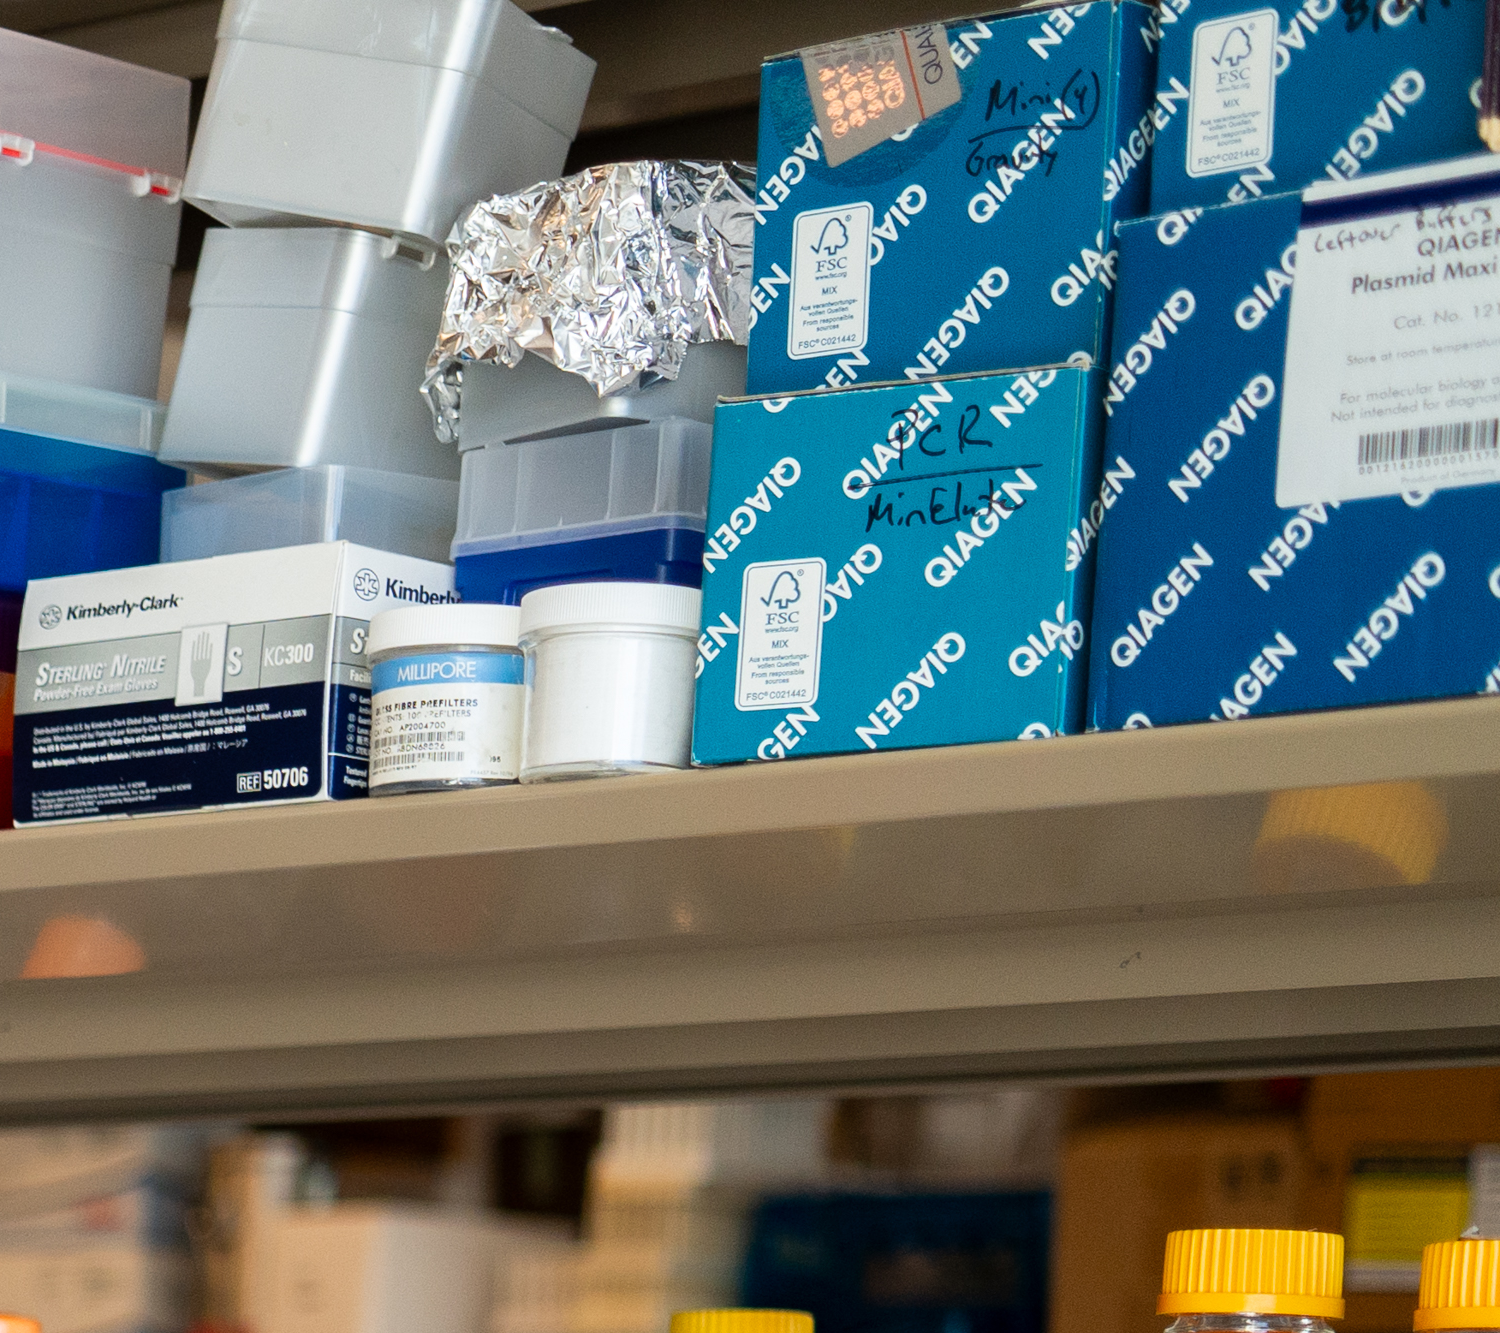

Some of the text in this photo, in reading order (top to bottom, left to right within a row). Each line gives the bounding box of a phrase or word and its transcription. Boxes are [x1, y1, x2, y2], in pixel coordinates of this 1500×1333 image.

[1217, 67, 1250, 85] FSC
[984, 79, 1054, 122] Mini
[1223, 99, 1240, 108] MIX
[968, 97, 1076, 224] QIAGEN
[1221, 148, 1260, 162] C021442
[815, 256, 848, 273] FSC
[1351, 256, 1498, 294] Plasmid Maxi
[821, 286, 838, 296] MIX
[802, 319, 819, 327] From
[904, 266, 1010, 382] QIAGEN
[821, 333, 856, 346] C021442
[1346, 354, 1376, 367] Store
[1396, 346, 1429, 359] room
[1339, 376, 1486, 405] For molecular biology
[1330, 399, 1441, 423] Not intended for
[842, 381, 953, 500] QIAGEN
[887, 405, 992, 470] PCR
[1168, 374, 1276, 503] QIAGEN
[703, 456, 801, 574] QIAGEN
[924, 468, 1038, 588] QIAGEN
[1110, 542, 1214, 668] QIAGEN
[1333, 551, 1446, 683] QIAGEN
[765, 611, 800, 626] FSC
[264, 643, 314, 667] KC300
[771, 639, 789, 649] MIX
[109, 654, 167, 679] NITRILE
[227, 646, 243, 676] S
[397, 661, 477, 683] MILLIPORE
[751, 671, 767, 679] From
[34, 678, 158, 702] Powder-Free Exam Gloves
[769, 689, 807, 699] C021442
[855, 632, 966, 750] QIAGEN
[394, 701, 417, 712] FIBRE
[399, 721, 446, 732] AP2004700
[238, 767, 308, 791] REF 50706
